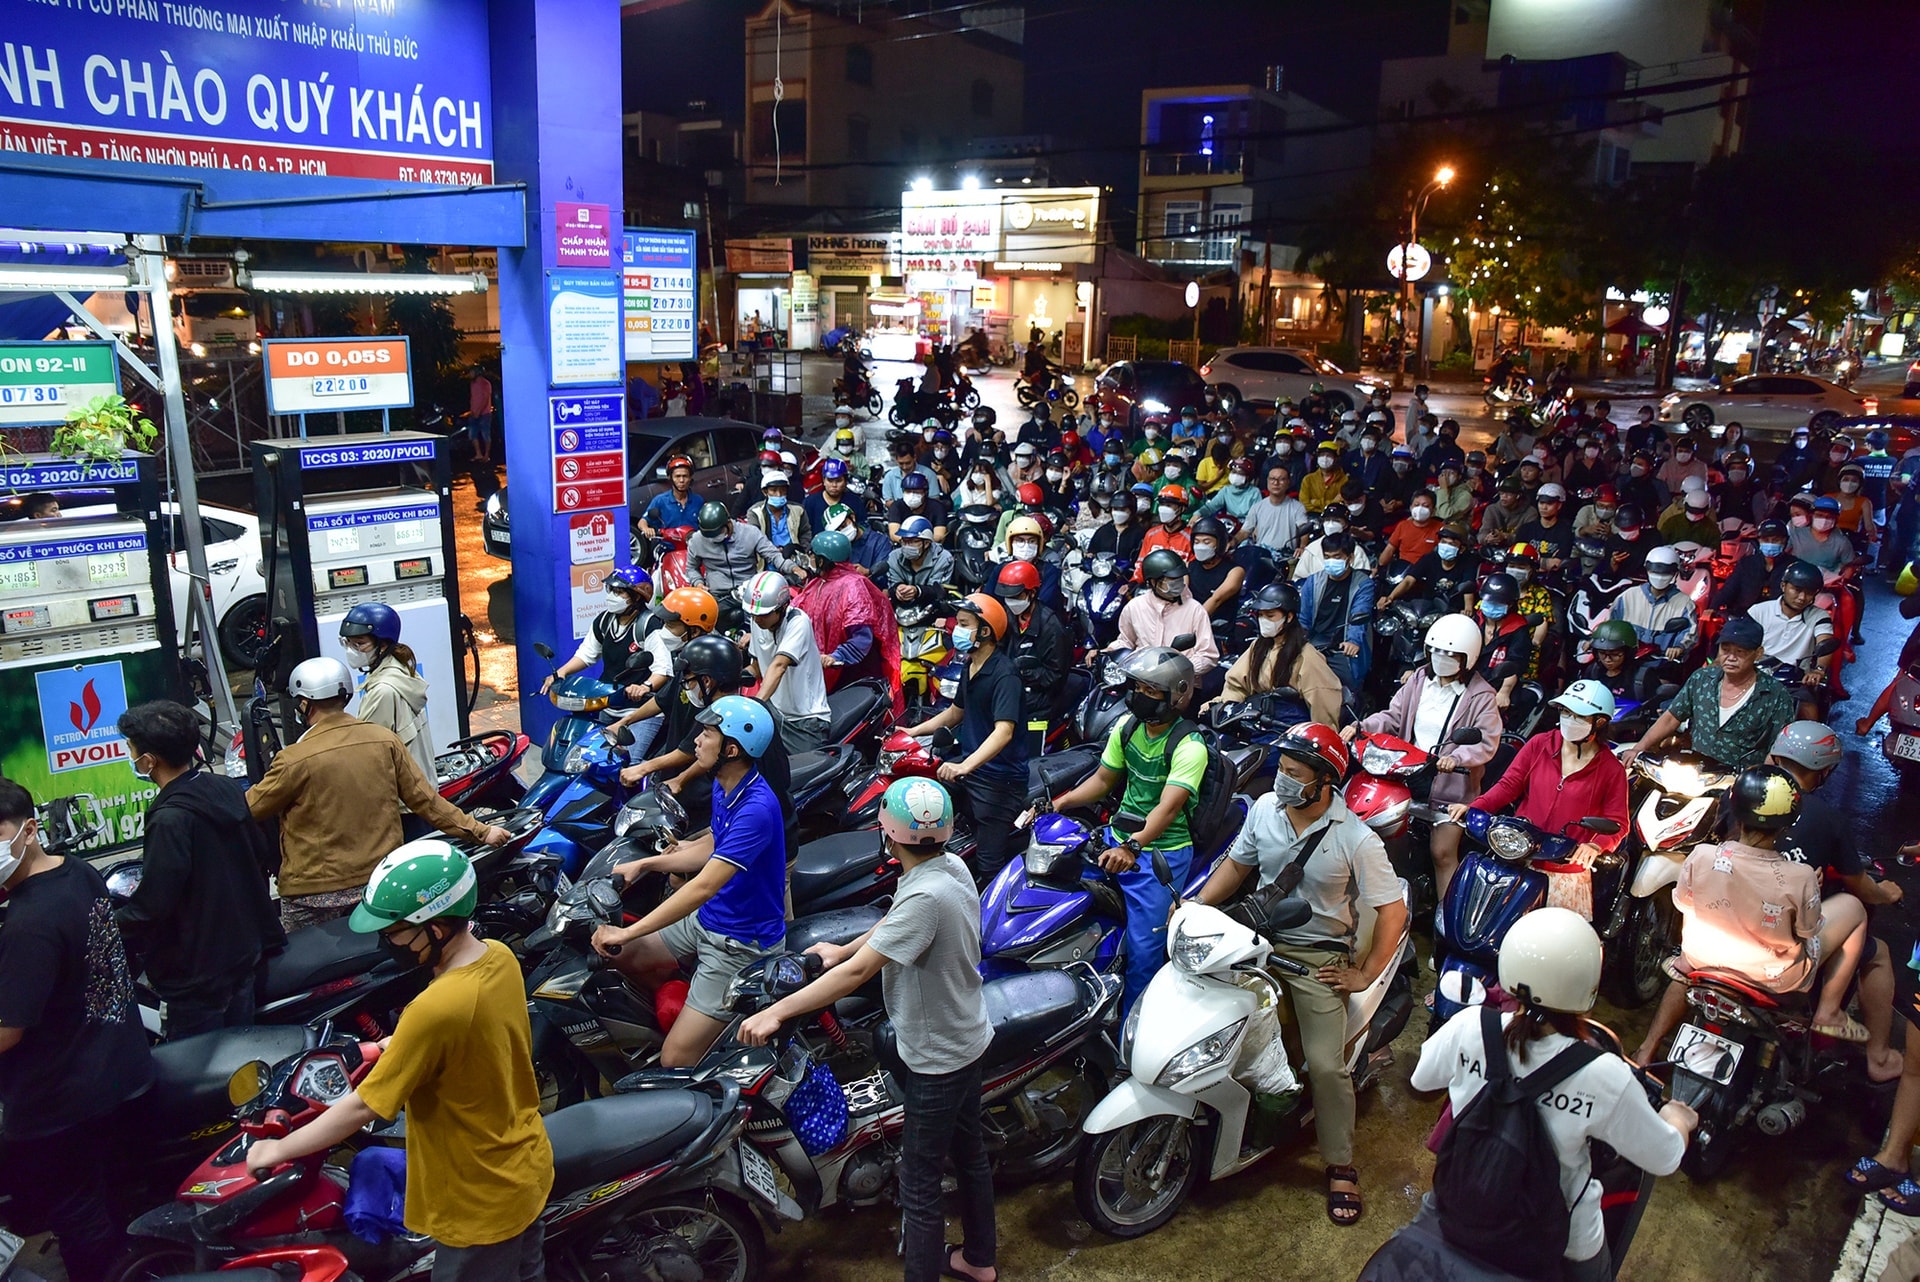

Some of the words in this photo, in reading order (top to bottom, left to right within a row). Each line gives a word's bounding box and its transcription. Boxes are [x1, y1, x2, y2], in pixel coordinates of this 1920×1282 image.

[163, 3, 223, 32] THƯƠNG
[227, 13, 253, 39] MẠI
[255, 14, 289, 42] XUẤT
[293, 22, 327, 49] NHẬP
[331, 24, 365, 52] KHẨU
[367, 31, 391, 57] THỦ
[394, 35, 419, 60] ĐỨC
[84, 50, 227, 126] CHÀO
[246, 72, 335, 136] QUÝ
[350, 84, 483, 149] KHÁCH
[562, 235, 584, 246] CHẤP
[585, 237, 607, 248] NHẬN
[852, 237, 888, 249] home
[560, 248, 587, 256] THANH
[588, 248, 610, 257] TOÁN
[654, 277, 693, 289] 21440
[654, 298, 692, 309] 20730
[653, 319, 690, 330] 22200
[0, 358, 32, 373] ON
[35, 357, 87, 373] 92-II
[287, 351, 320, 366] DO
[326, 349, 391, 367] 0,05S
[315, 378, 368, 393] 22200
[304, 453, 338, 465] TCCS
[340, 451, 360, 463] 03:
[362, 445, 431, 461] 2020/PVOIL
[10, 473, 36, 486] 02:
[313, 519, 330, 529] TRẢ
[331, 516, 343, 526] SỐ
[345, 514, 356, 525] VỀ
[373, 511, 401, 522] TRƯỚC
[402, 510, 416, 519] KHI
[418, 508, 436, 518] BƠM
[0, 548, 15, 560] SỐ
[18, 546, 33, 558] VỀ
[57, 543, 94, 555] TRƯỚC
[97, 540, 115, 550] KHI
[118, 538, 142, 549] BƠM
[56, 742, 126, 768] PVOIL
[429, 895, 451, 912] HELP
[561, 1020, 599, 1035] YAMAHA
[1541, 1089, 1594, 1120] 2021
